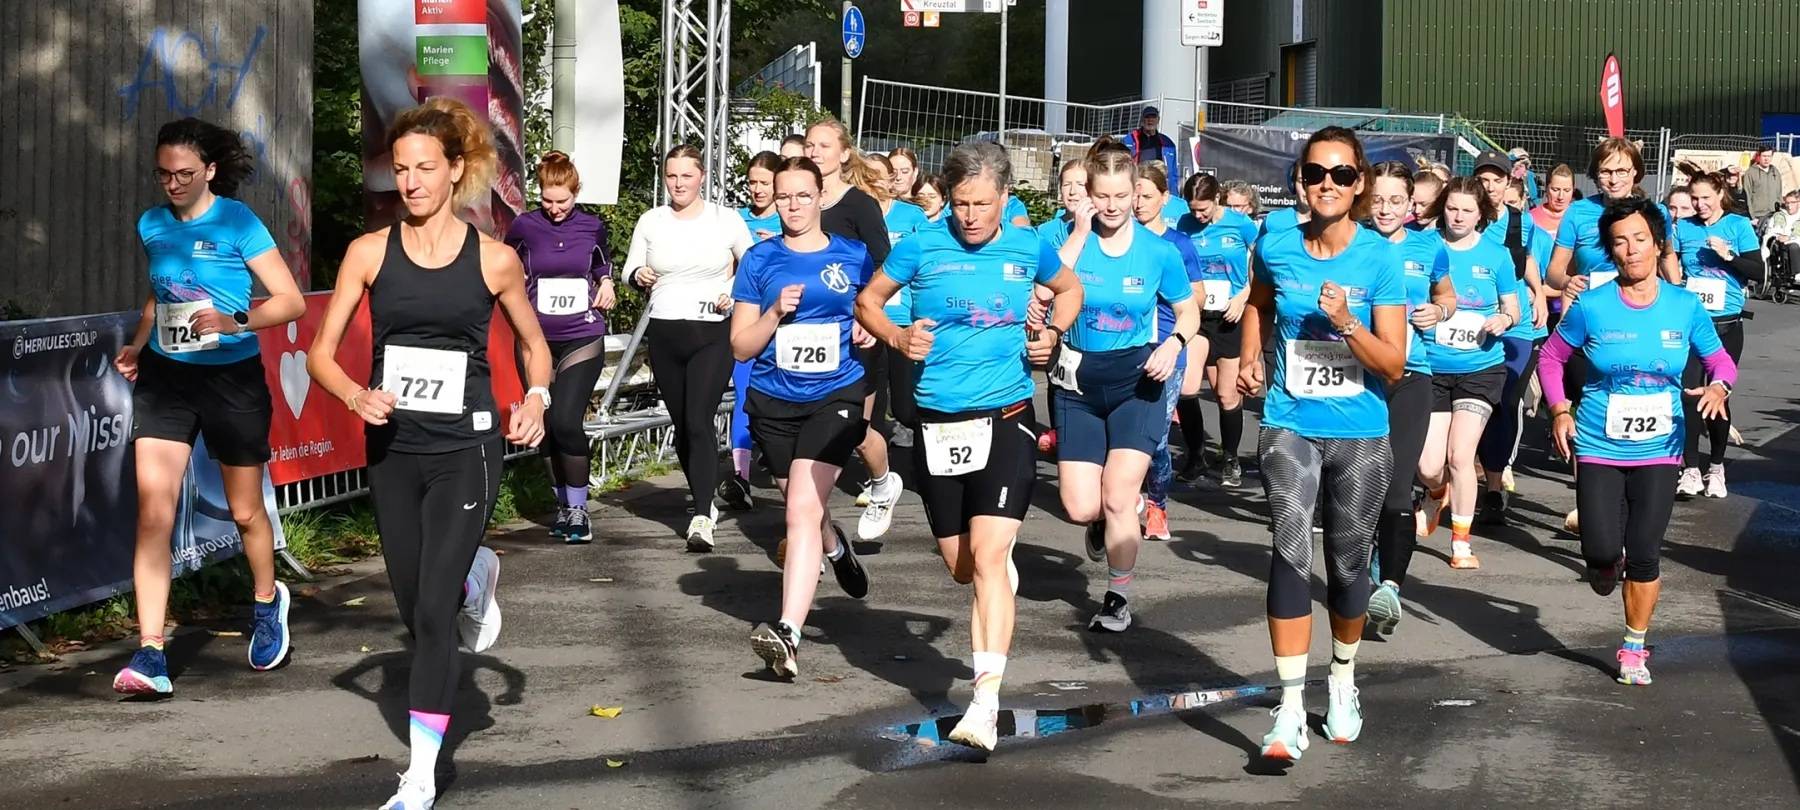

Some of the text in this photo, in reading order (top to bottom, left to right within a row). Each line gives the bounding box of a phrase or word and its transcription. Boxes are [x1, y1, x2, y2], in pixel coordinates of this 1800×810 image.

[422, 6, 443, 14] Aktiv
[923, 0, 957, 8] Kreuztal
[423, 46, 454, 54] Marien
[423, 57, 450, 66] Pflege
[1259, 197, 1297, 206] hinenba
[550, 295, 576, 309] 707
[1697, 292, 1714, 304] 38
[698, 301, 718, 315] 70
[24, 331, 98, 354] HERKULESGROUP
[168, 326, 201, 344] 724
[1448, 328, 1475, 343] 736
[792, 346, 826, 364] 726
[1304, 366, 1345, 386] 735
[401, 376, 444, 400] 727
[1622, 416, 1657, 433] 732
[11, 425, 60, 467] our
[279, 445, 298, 461] leben
[299, 442, 309, 457] die
[310, 438, 335, 457] Region.
[949, 446, 972, 465] 52
[0, 577, 51, 612] enbaus!
